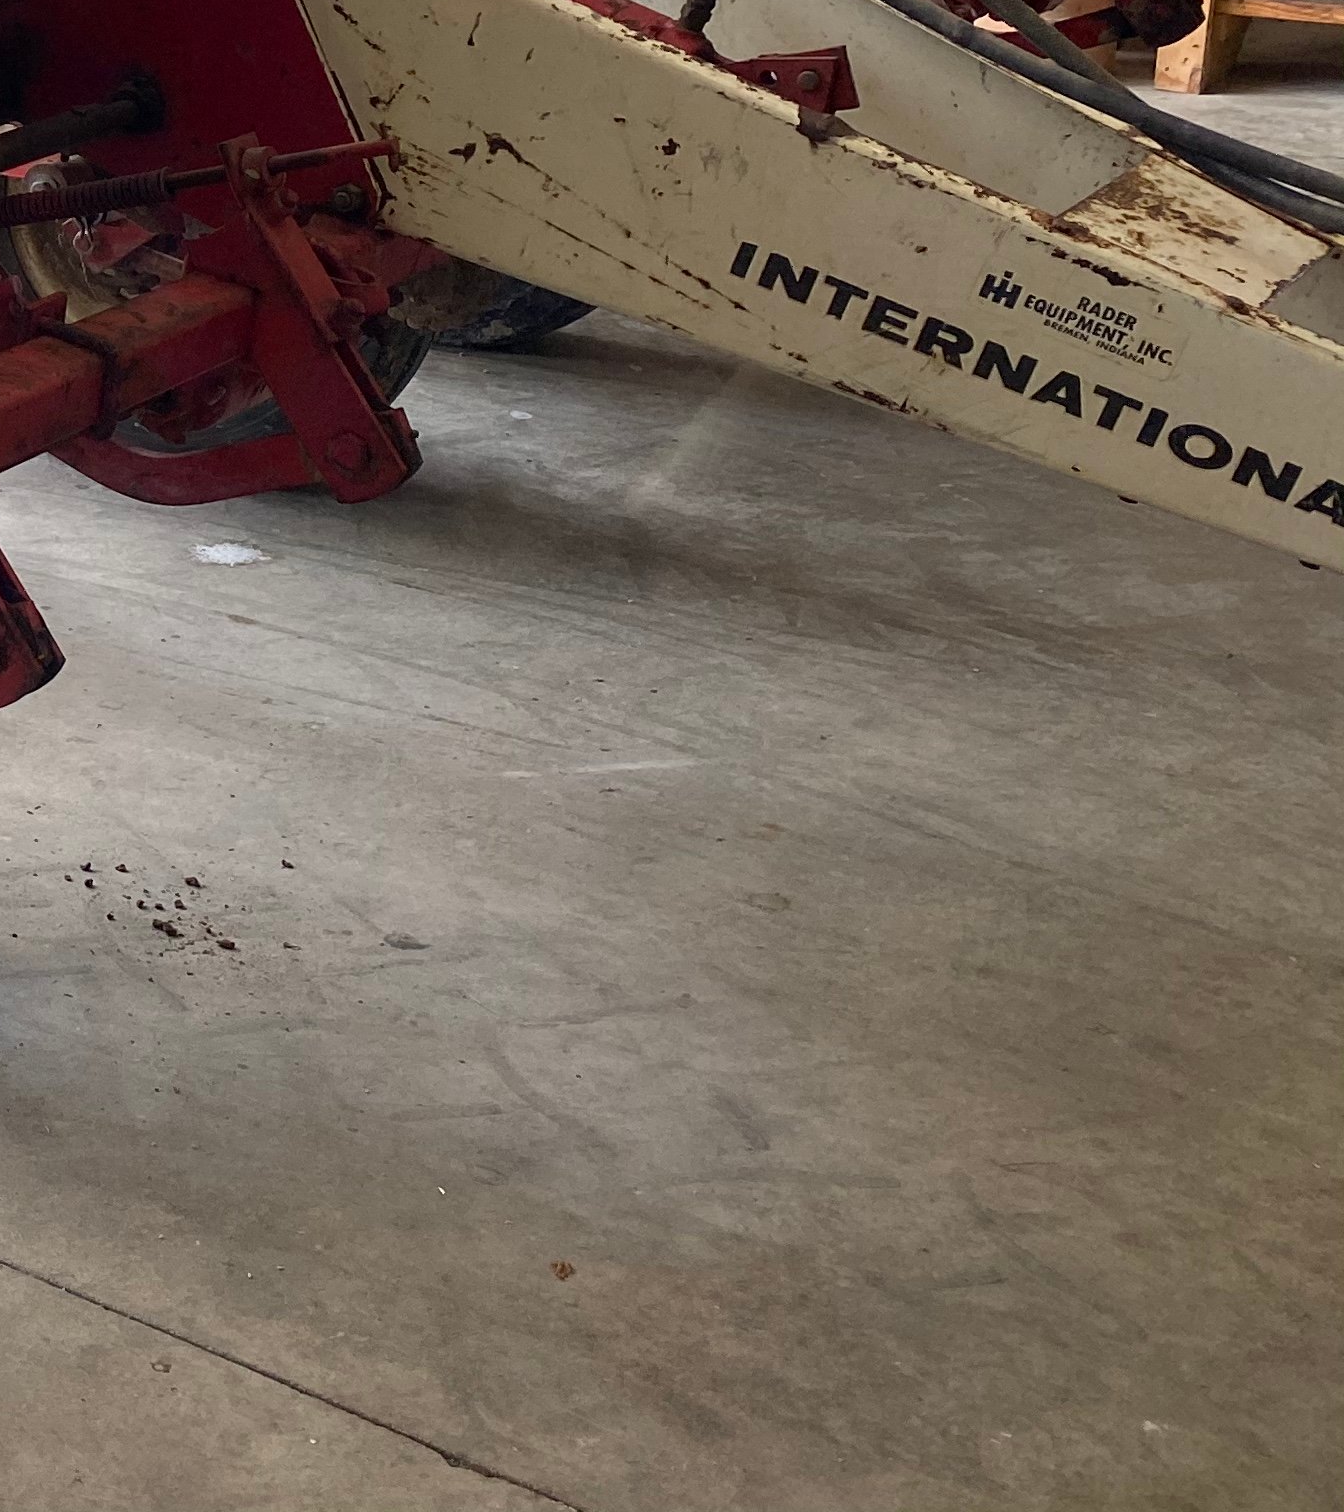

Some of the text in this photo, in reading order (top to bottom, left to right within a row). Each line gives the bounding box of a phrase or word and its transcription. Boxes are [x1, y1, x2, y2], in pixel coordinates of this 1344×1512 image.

[1024, 294, 1173, 366] EQUIPMENT, INC.
[1043, 319, 1145, 365] BREMEN, INDIANA
[1077, 296, 1138, 331] RADER
[729, 241, 1344, 528] INTERNATIONA
